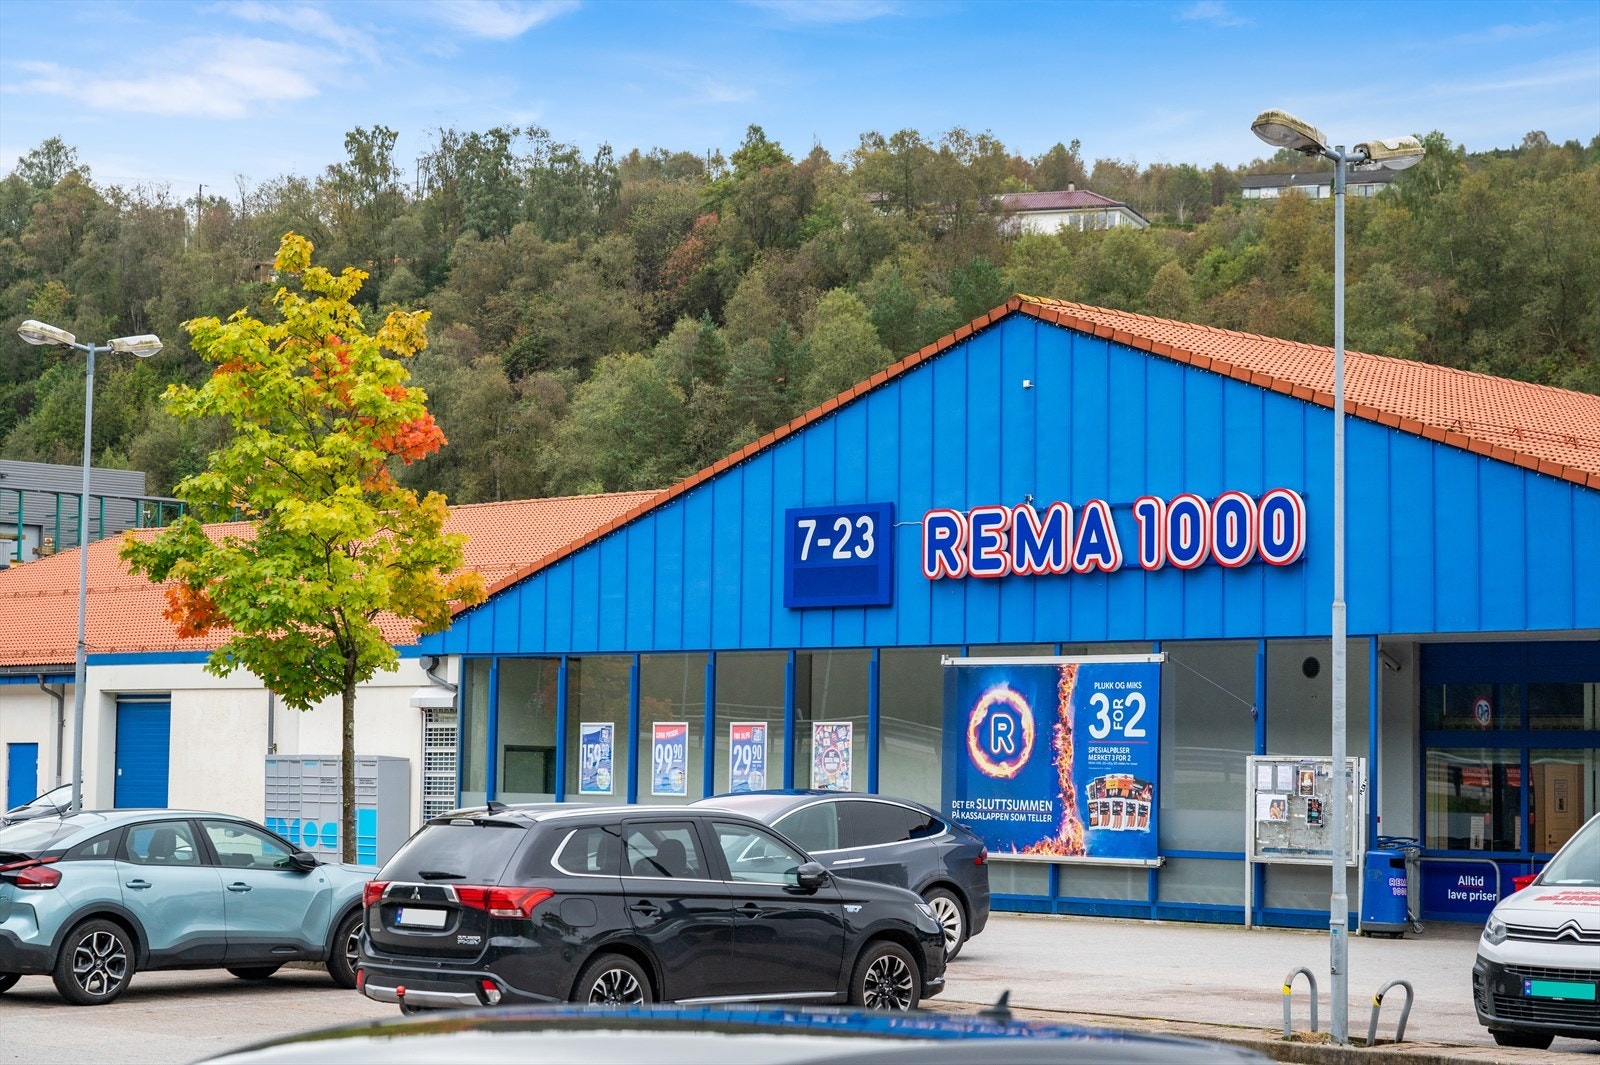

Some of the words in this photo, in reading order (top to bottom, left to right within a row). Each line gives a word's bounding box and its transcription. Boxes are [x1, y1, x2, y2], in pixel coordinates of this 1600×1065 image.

[797, 515, 874, 561] 7-23
[922, 498, 1122, 580] REMA
[1133, 487, 1306, 572] 1000
[1089, 692, 1111, 739] 3
[1113, 699, 1124, 730] FOR
[1124, 692, 1146, 737] 2
[990, 713, 1015, 754] R
[966, 801, 975, 809] ER
[976, 798, 1053, 812] SLUTTSUMMEN
[952, 810, 960, 819] PÅ
[961, 811, 1009, 821] KASSALAPPEN
[1028, 814, 1052, 822] TELLER
[1388, 878, 1407, 886] REM
[1458, 875, 1484, 886] Alltid
[1448, 889, 1467, 900] lave
[1469, 890, 1496, 902] priser
